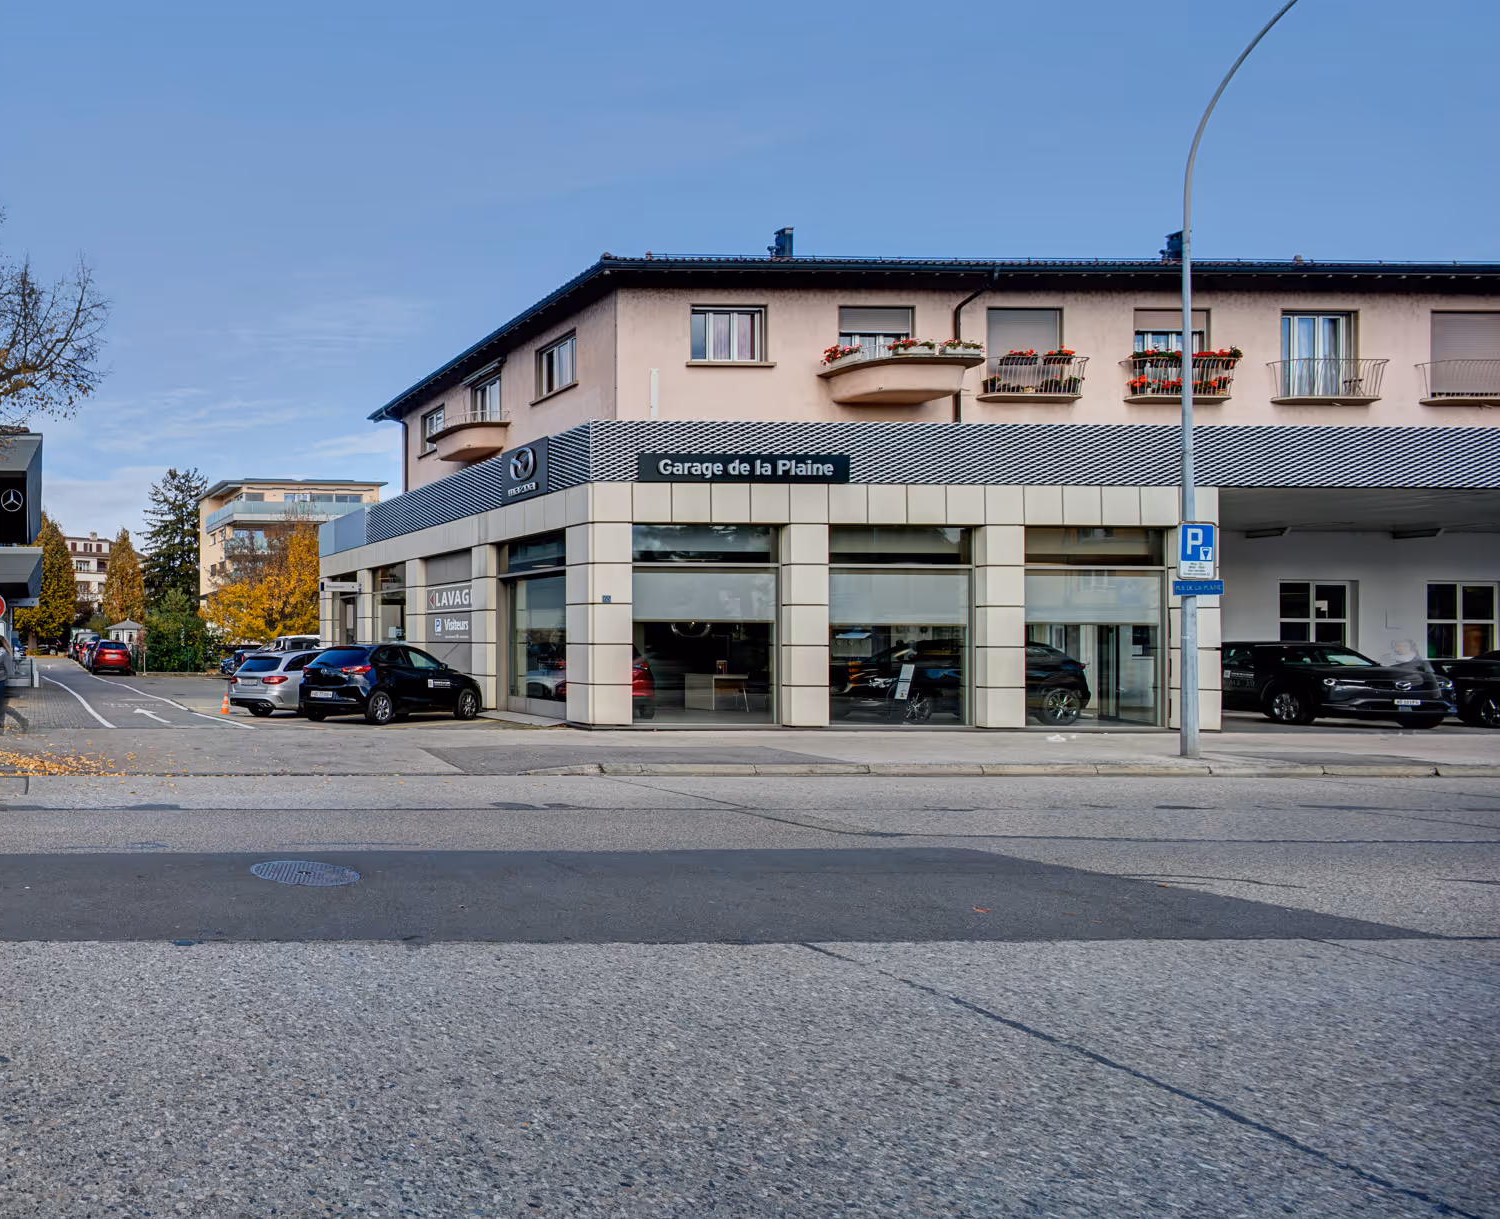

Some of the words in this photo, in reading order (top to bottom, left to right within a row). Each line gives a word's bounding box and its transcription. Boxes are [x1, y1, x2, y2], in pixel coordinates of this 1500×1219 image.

[658, 459, 723, 479] Garage
[727, 460, 750, 475] de
[754, 460, 772, 475] la
[777, 460, 834, 476] Plaine
[1186, 528, 1203, 555] P
[444, 618, 469, 631] Visiteurs
